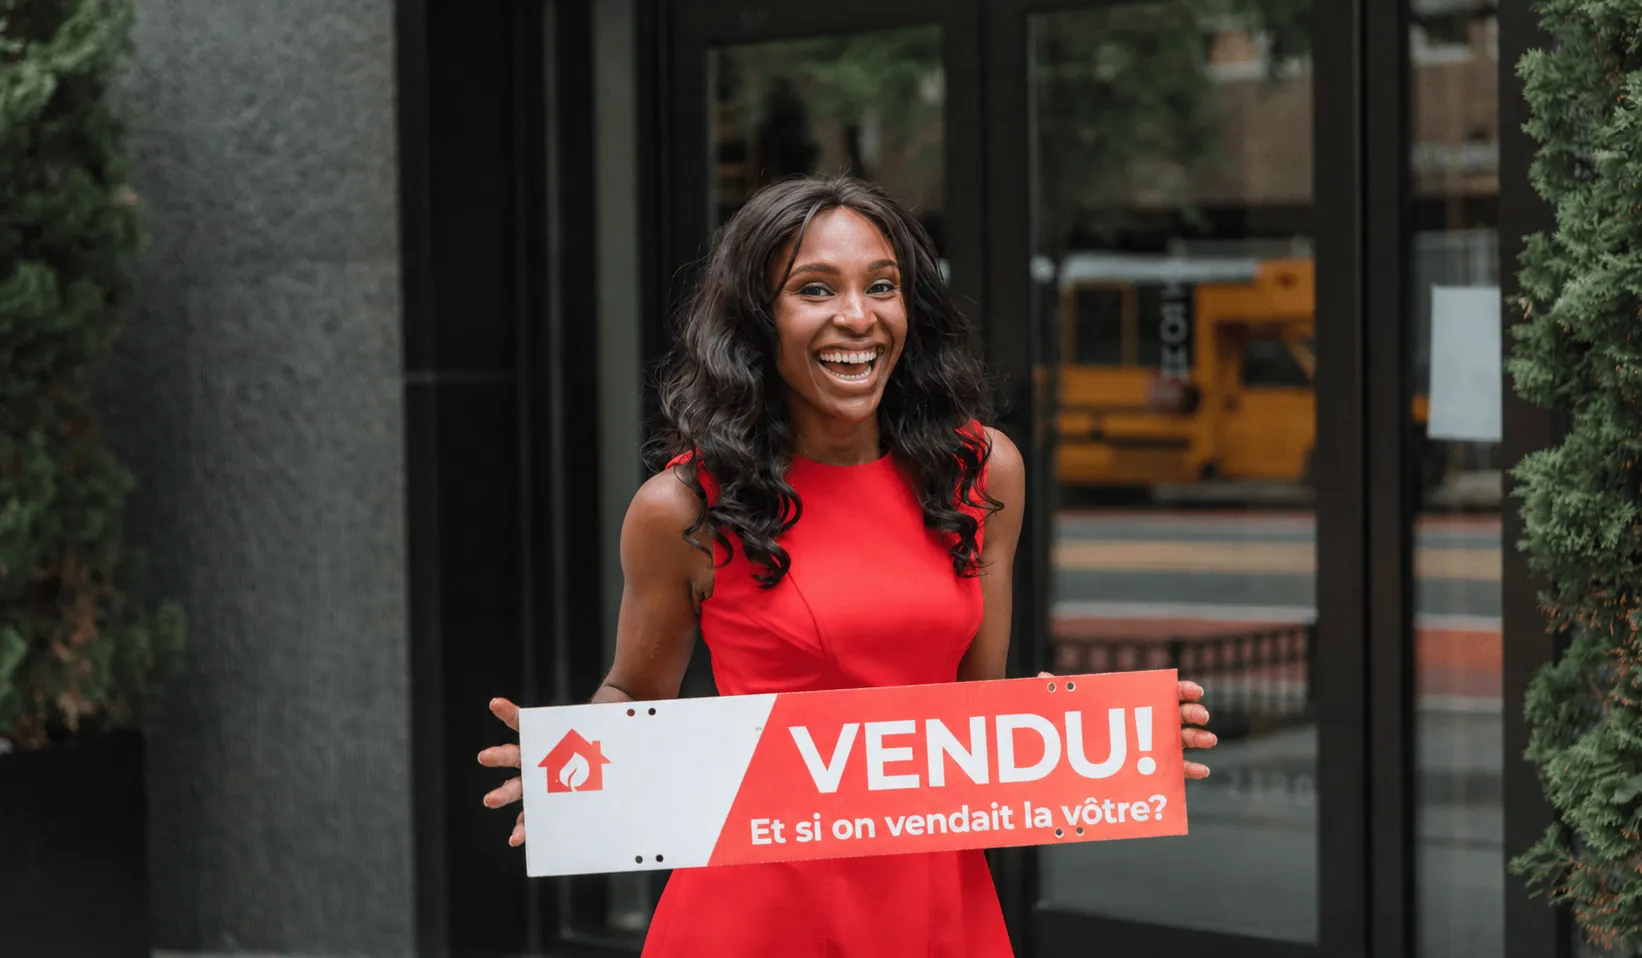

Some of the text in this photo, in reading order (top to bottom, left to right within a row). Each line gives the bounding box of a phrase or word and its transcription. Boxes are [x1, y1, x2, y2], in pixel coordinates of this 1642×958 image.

[788, 705, 1157, 794] VENDU!
[750, 793, 1168, 845] Et si on vendait la vôtre?
